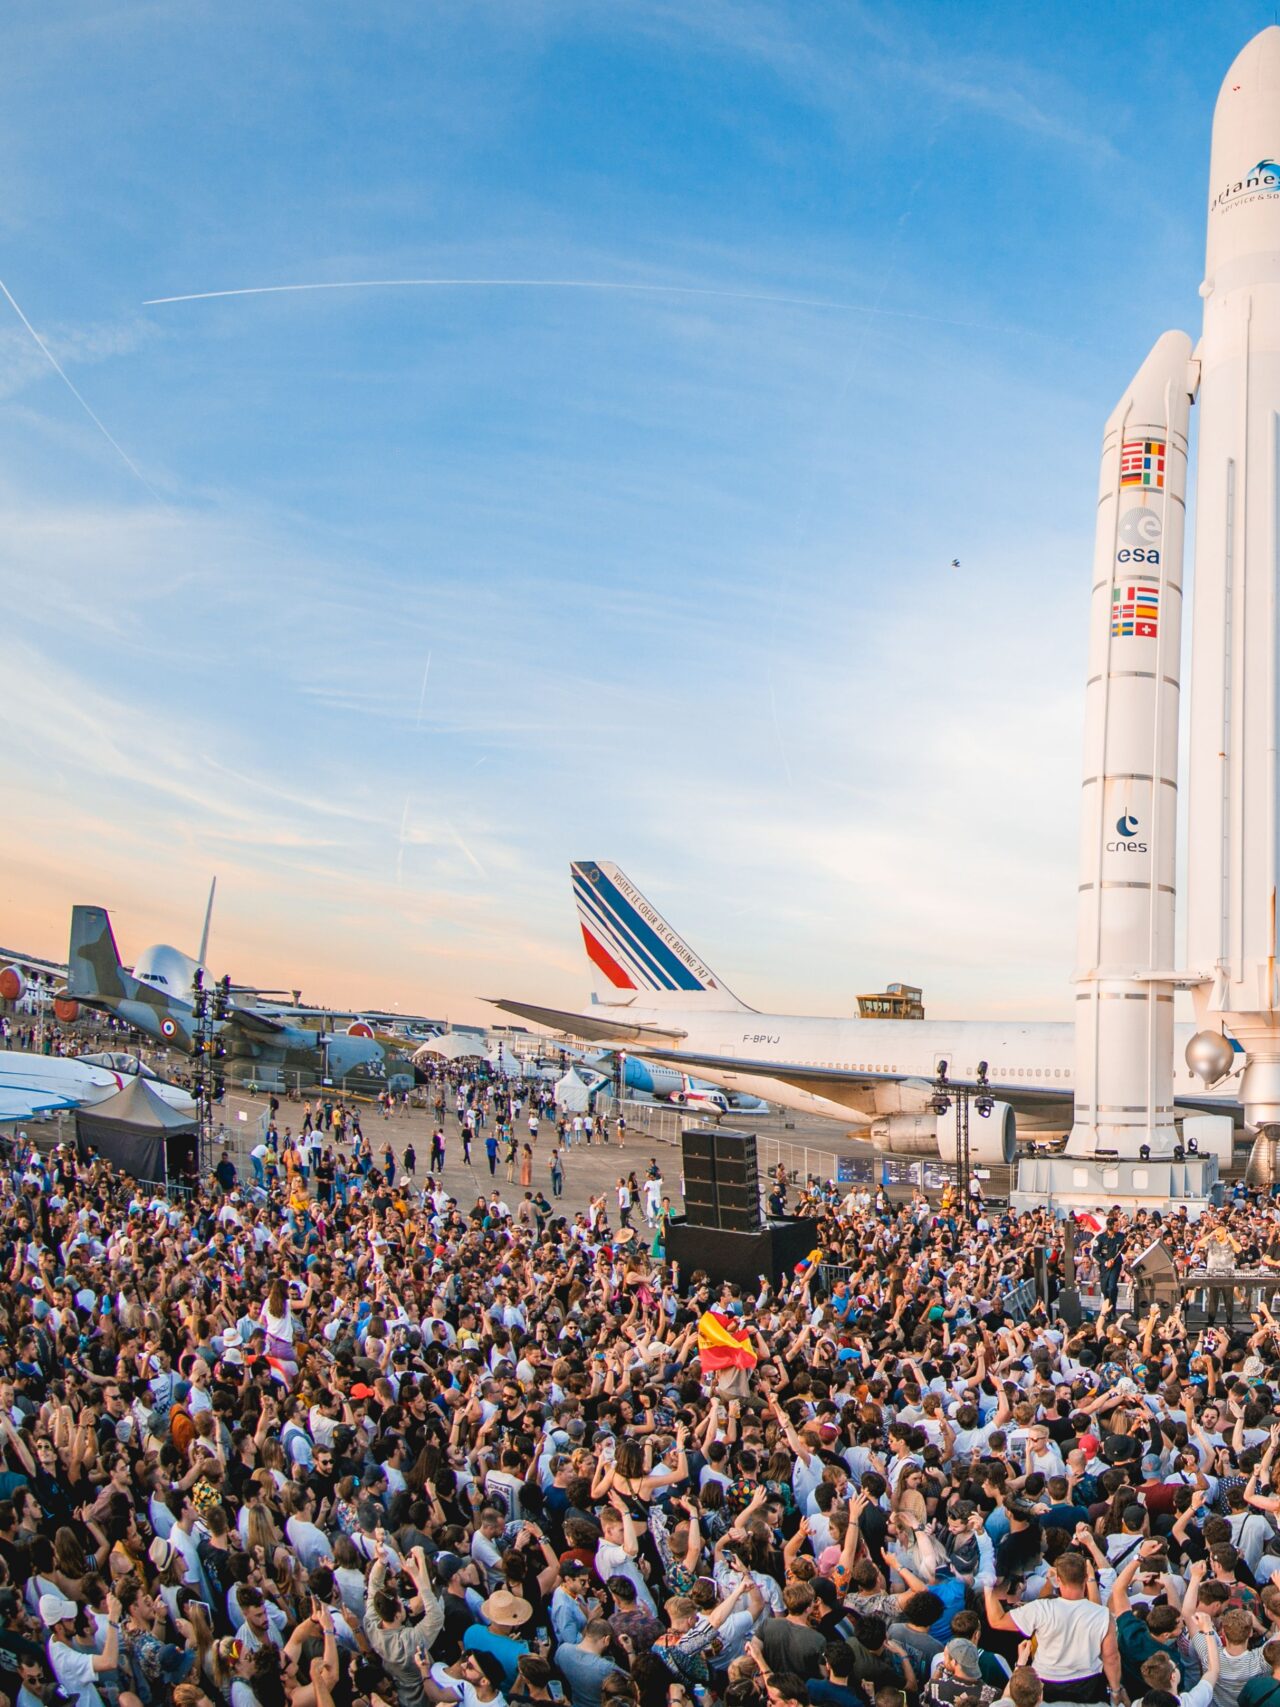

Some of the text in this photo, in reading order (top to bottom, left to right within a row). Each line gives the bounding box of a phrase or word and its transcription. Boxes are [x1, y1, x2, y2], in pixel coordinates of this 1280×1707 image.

[1117, 548, 1160, 565] esa
[1106, 842, 1148, 852] cnes
[613, 872, 709, 979] VISITEZ LE COEUR DE CE BOEING 747
[743, 1034, 781, 1044] F-BPVJ
